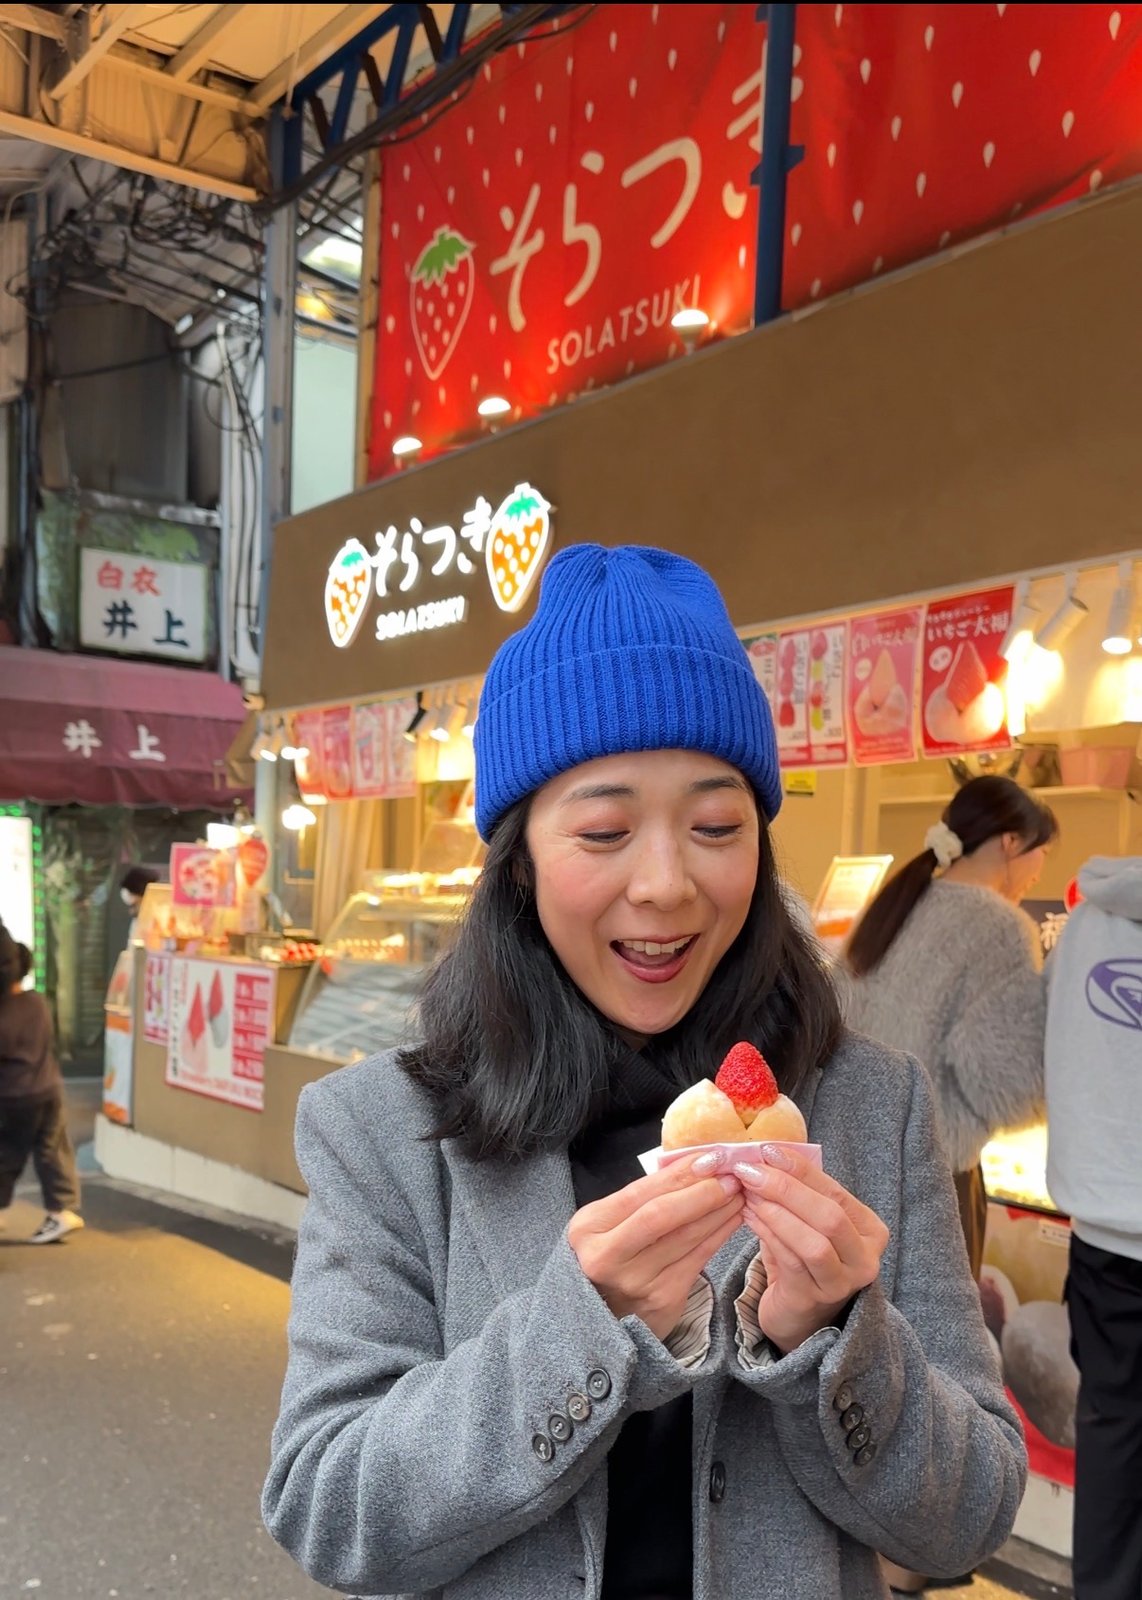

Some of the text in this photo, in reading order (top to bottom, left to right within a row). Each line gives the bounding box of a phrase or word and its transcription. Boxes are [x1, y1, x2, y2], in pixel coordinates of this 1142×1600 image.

[546, 273, 700, 374] SOLATSUKI
[370, 496, 492, 598] そらつき
[97, 561, 161, 597] 白衣
[103, 600, 190, 648] 井上
[62, 719, 166, 763] 井上
